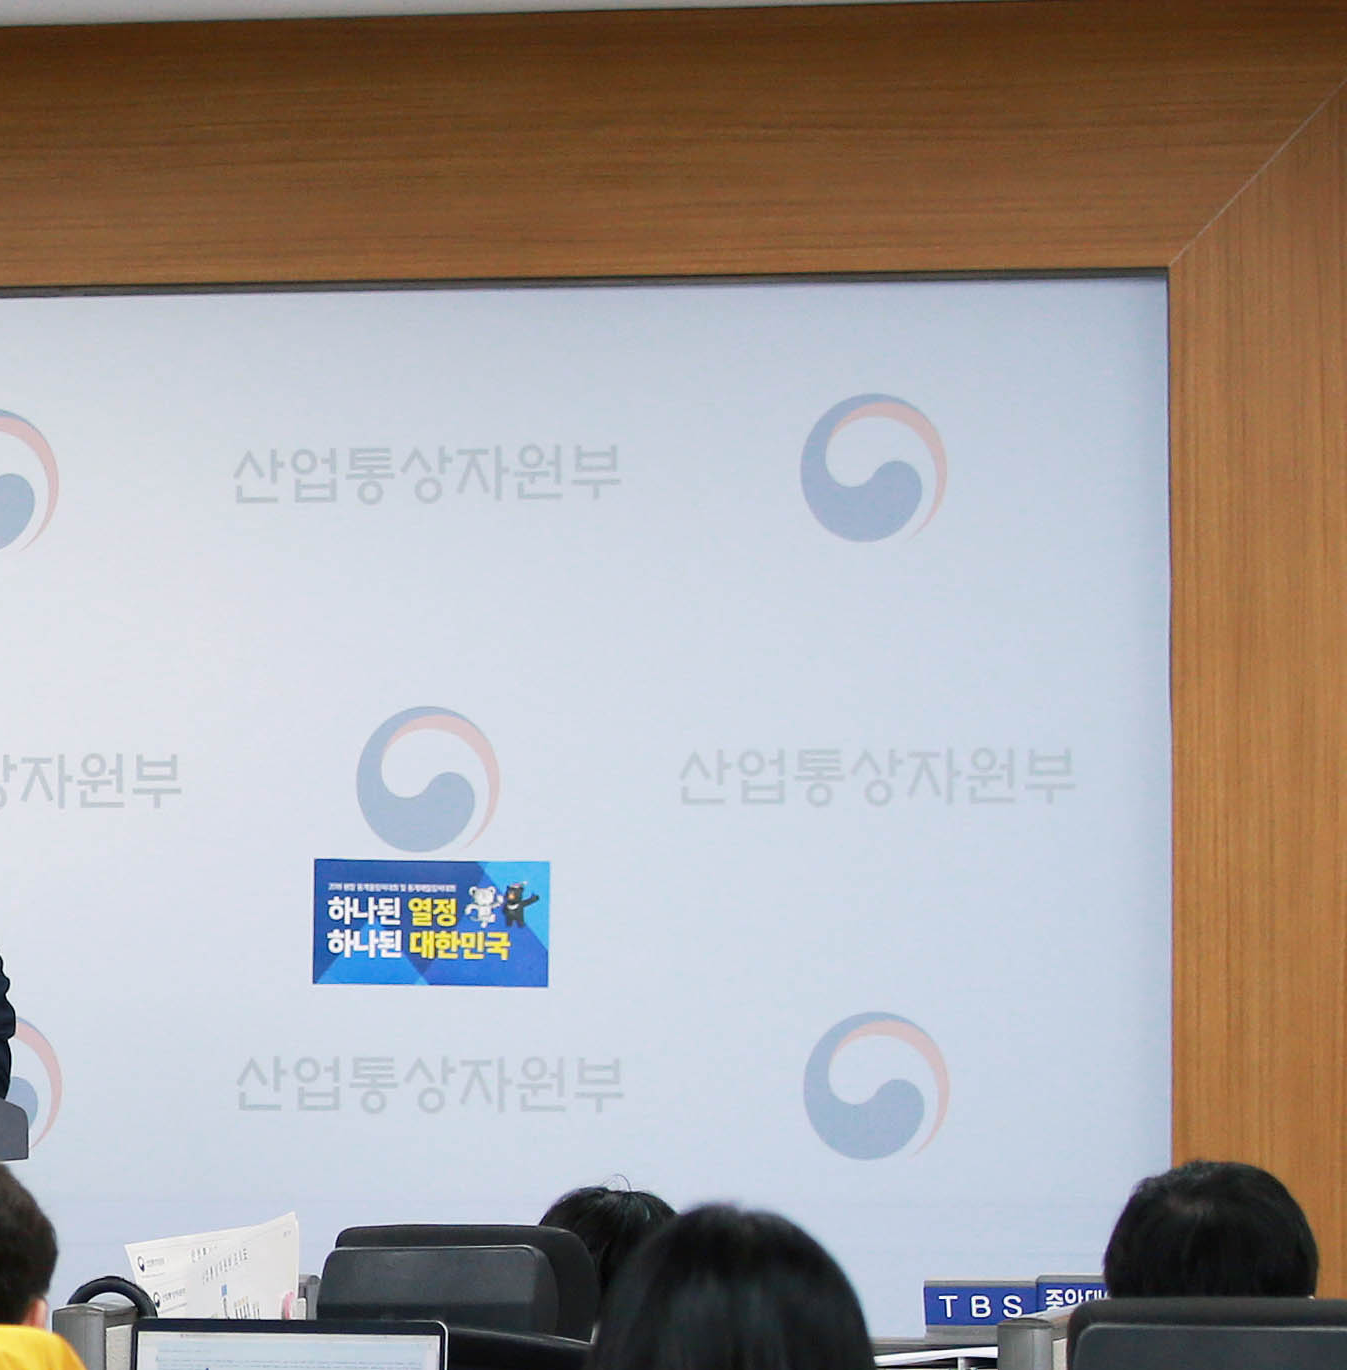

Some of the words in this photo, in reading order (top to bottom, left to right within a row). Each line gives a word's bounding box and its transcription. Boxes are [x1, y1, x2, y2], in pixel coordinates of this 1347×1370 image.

[234, 444, 622, 505] 산업통상자원부
[679, 747, 1076, 806] 산업통상자원부
[327, 896, 401, 925] 하나된
[408, 898, 457, 926] 열정
[327, 929, 403, 958] 하나된
[409, 931, 511, 960] 대한민국
[237, 1057, 624, 1114] 산업통상자원부
